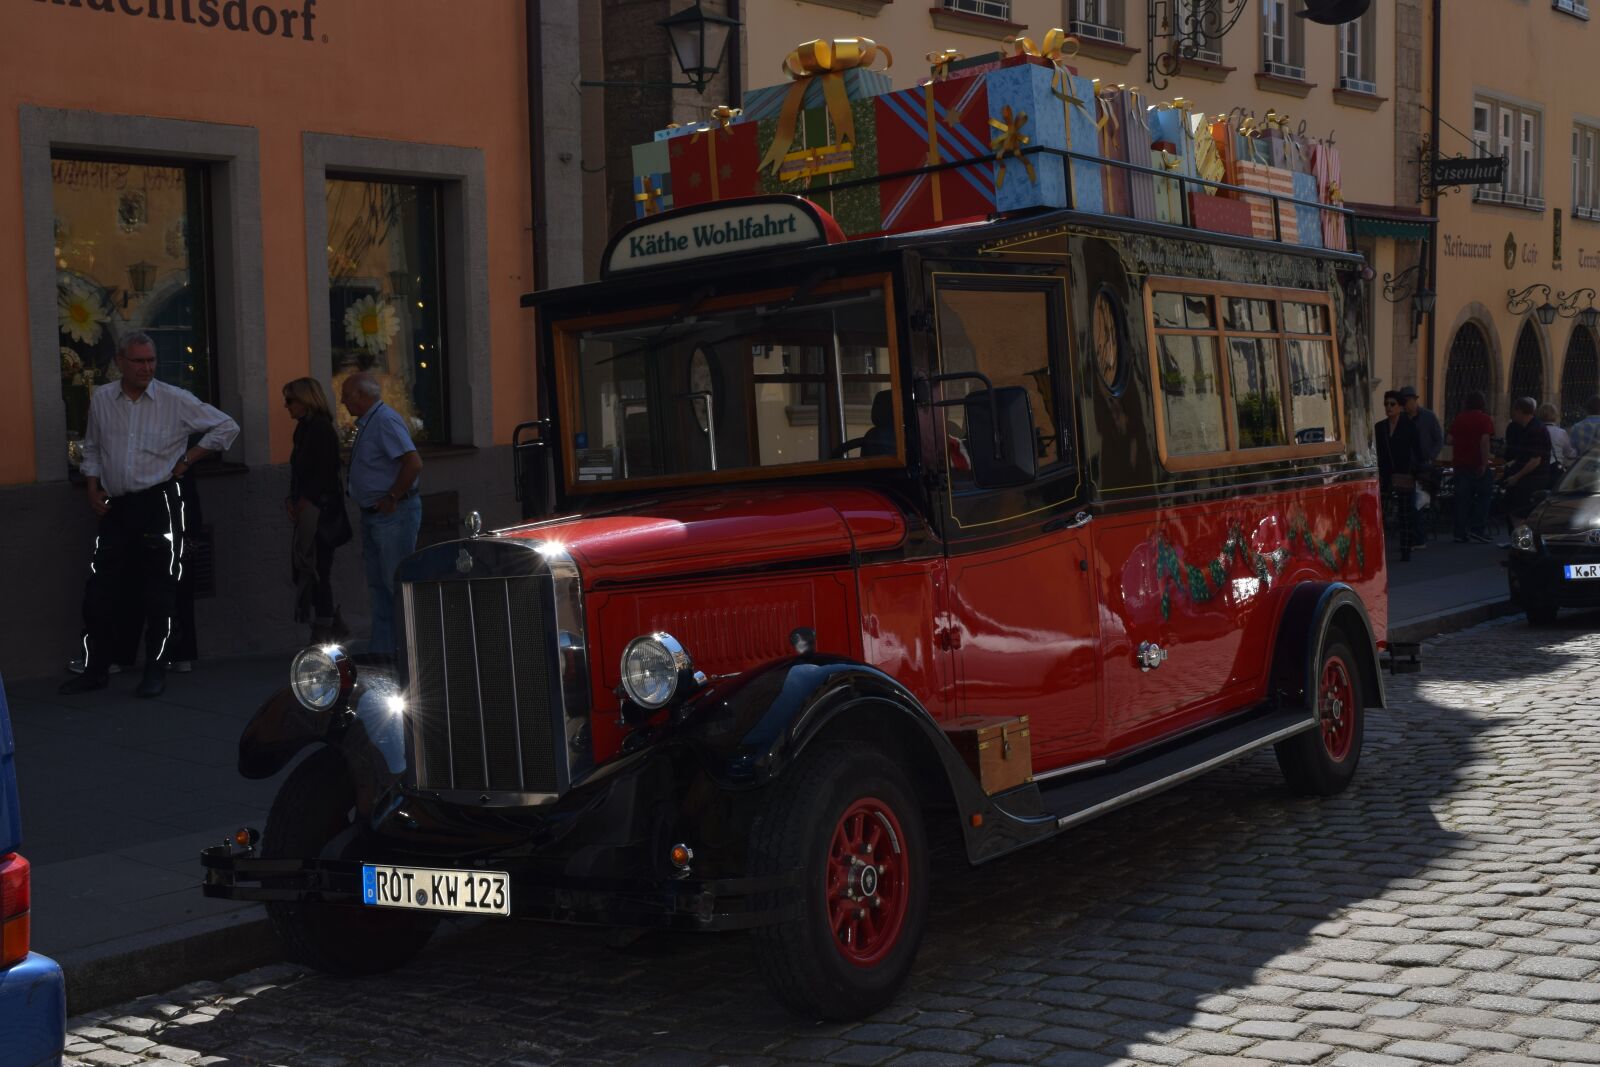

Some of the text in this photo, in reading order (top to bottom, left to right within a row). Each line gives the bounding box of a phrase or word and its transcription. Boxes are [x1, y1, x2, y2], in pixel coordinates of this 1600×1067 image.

[1434, 164, 1499, 181] Eisenhut
[630, 213, 796, 258] Käthe Wohlfahrt
[431, 874, 459, 906] KW
[464, 877, 506, 909] 123
